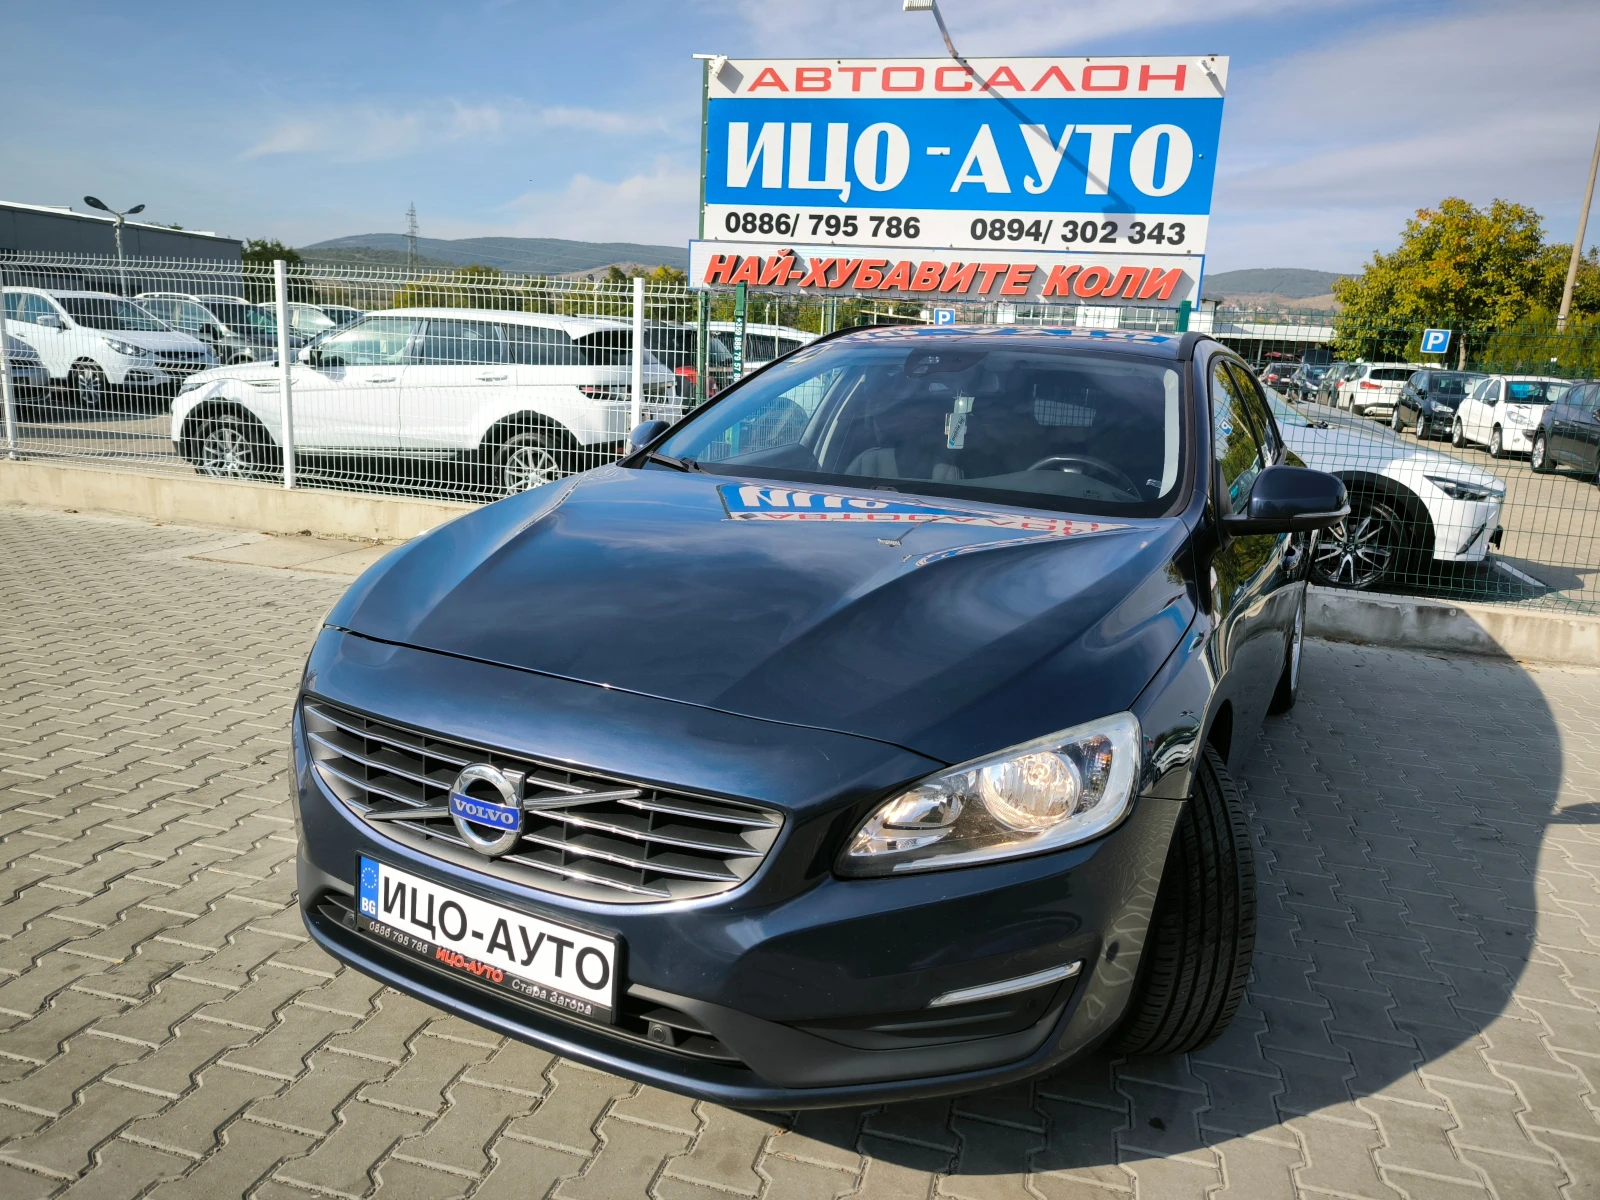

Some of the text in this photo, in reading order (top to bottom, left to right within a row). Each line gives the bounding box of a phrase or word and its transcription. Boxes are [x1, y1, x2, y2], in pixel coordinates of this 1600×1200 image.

[747, 64, 1186, 92] АВТОСАЛОН
[725, 212, 921, 239] 0886/ 795 786
[970, 218, 1186, 245] 0894/ 302 343
[703, 249, 1183, 299] НАЙ-ХУБАВИТЕ КОЛИ
[1426, 332, 1444, 350] P
[453, 797, 514, 825] VOLVO
[361, 896, 376, 915] BG
[369, 921, 428, 954] 0886 795 786
[383, 875, 610, 991] ИЦО-АУТО
[435, 947, 504, 983] ИЦО-АУТО
[511, 979, 593, 1015] Стара Загора
